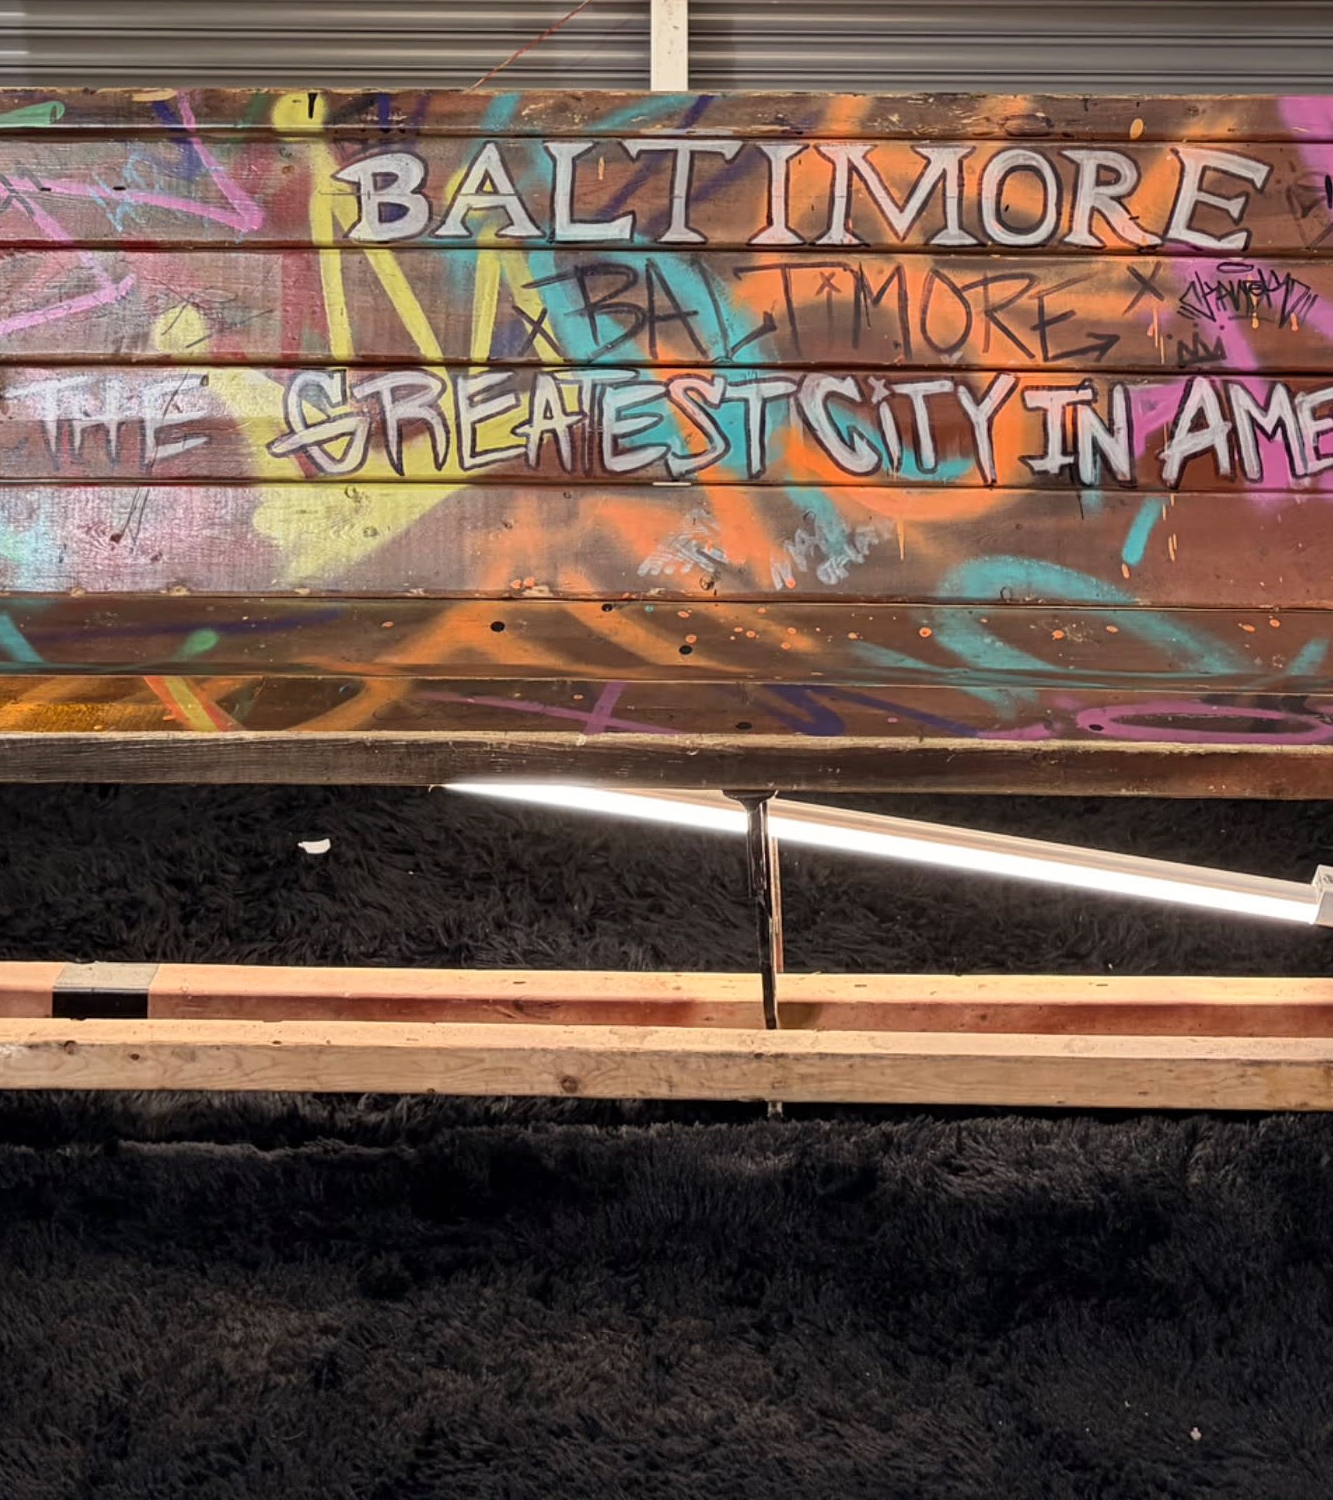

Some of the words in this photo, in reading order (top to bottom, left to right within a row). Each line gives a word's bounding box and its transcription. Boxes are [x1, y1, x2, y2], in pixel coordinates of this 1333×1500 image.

[331, 138, 1274, 253] BALTIMORE
[267, 367, 804, 481] GREATEST
[1017, 376, 1139, 488] IN
